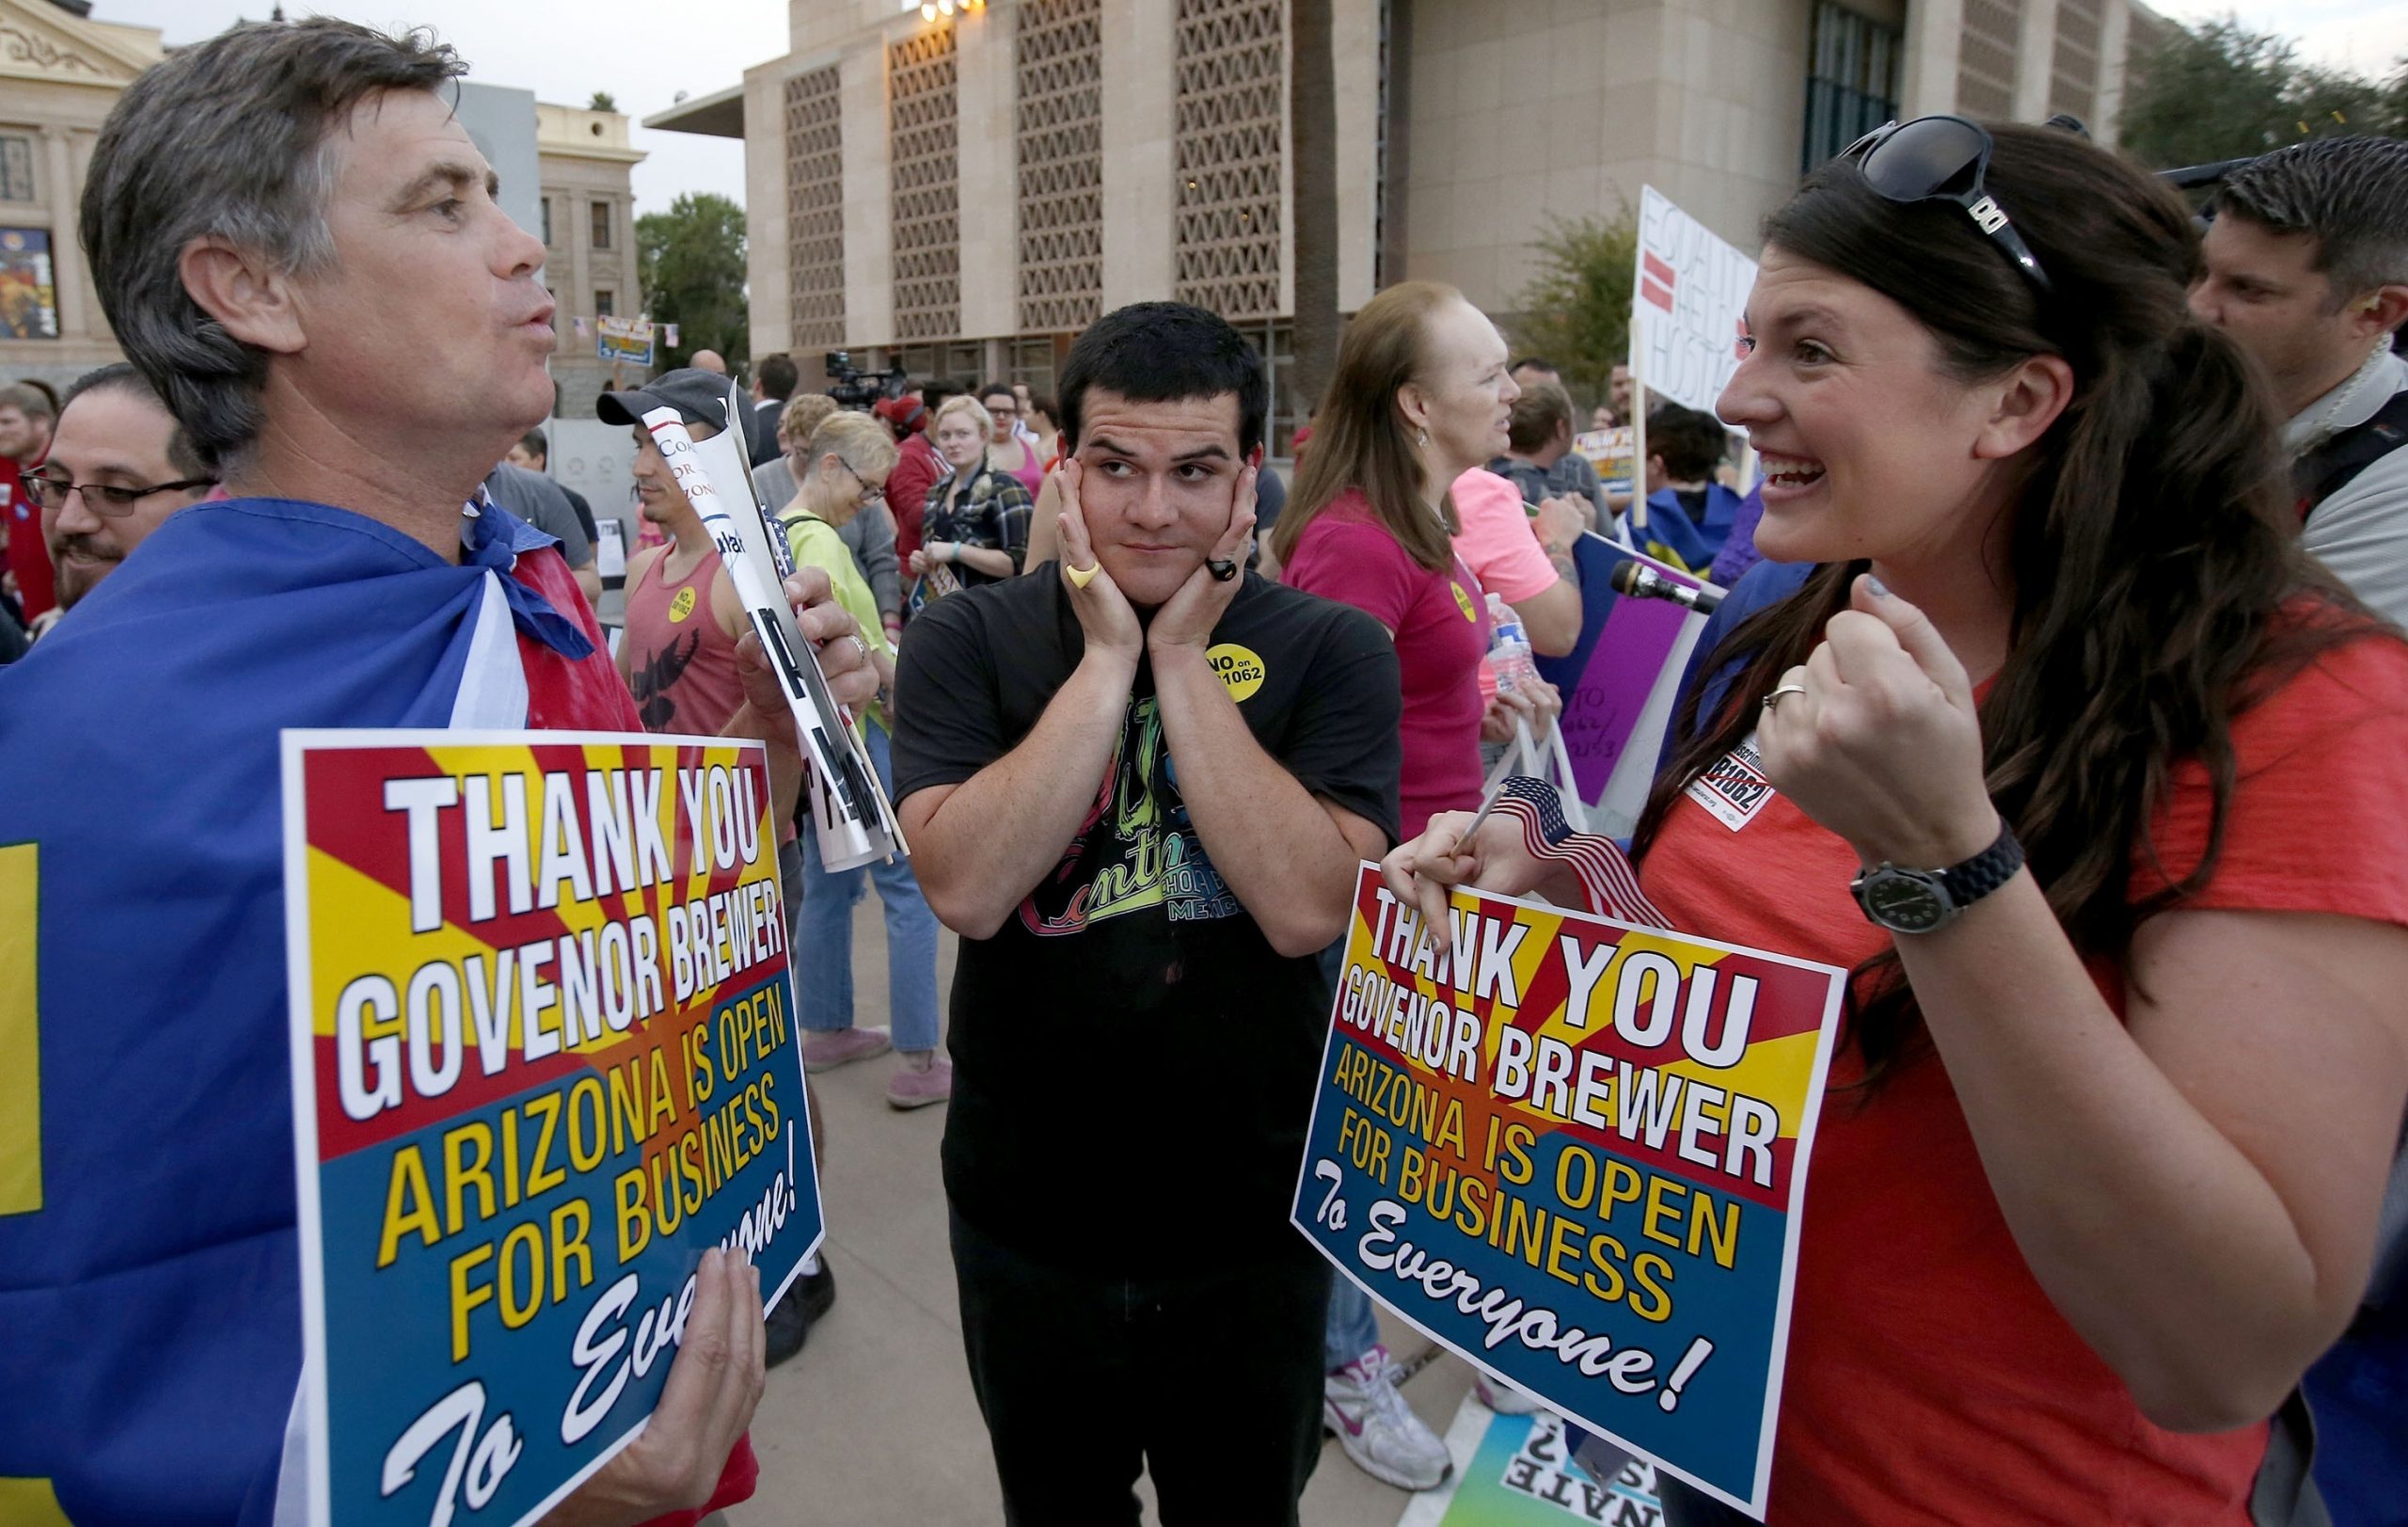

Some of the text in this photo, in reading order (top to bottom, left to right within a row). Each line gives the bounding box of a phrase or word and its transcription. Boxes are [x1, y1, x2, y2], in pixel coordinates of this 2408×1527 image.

[1207, 656, 1234, 672] NO
[1218, 667, 1262, 685] 1062
[383, 766, 673, 934] THANK
[677, 764, 760, 876] YOU
[335, 877, 784, 1122] GOVENOR BREWER
[1340, 962, 1782, 1189] GOVENOR BREWER
[1559, 934, 1761, 1071] YOU
[376, 981, 786, 1270] ARIZONA IS OPEN
[449, 1071, 780, 1364] FOR BUSINESS
[1333, 1042, 1743, 1271] ARIZONA IS OPEN
[1337, 1105, 1676, 1323] FOR BUSINESS
[381, 1119, 798, 1527] To Eveone!
[1314, 1158, 1715, 1414] To Everyone!
